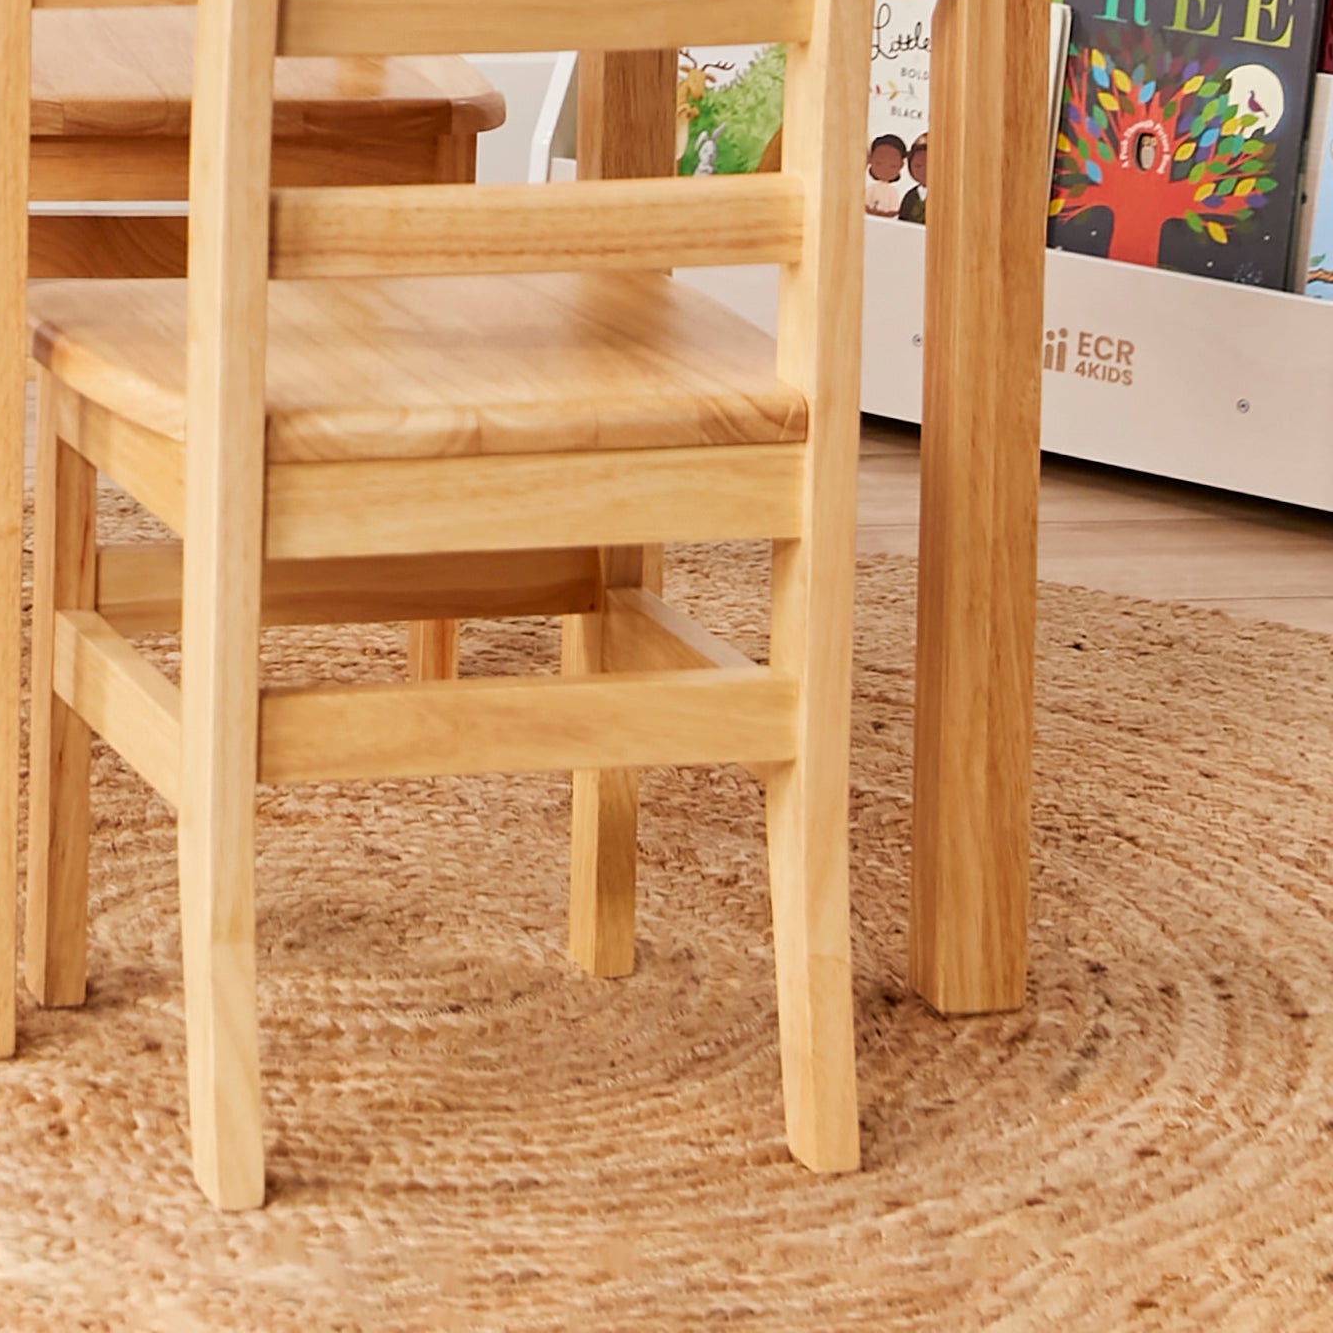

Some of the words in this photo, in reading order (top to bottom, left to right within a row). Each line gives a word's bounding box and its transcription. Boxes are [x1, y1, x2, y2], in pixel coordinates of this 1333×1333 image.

[871, 3, 931, 60] Little
[890, 106, 923, 119] BLACK
[1077, 331, 1135, 366] ECR
[1074, 361, 1134, 386] 4KIDS
